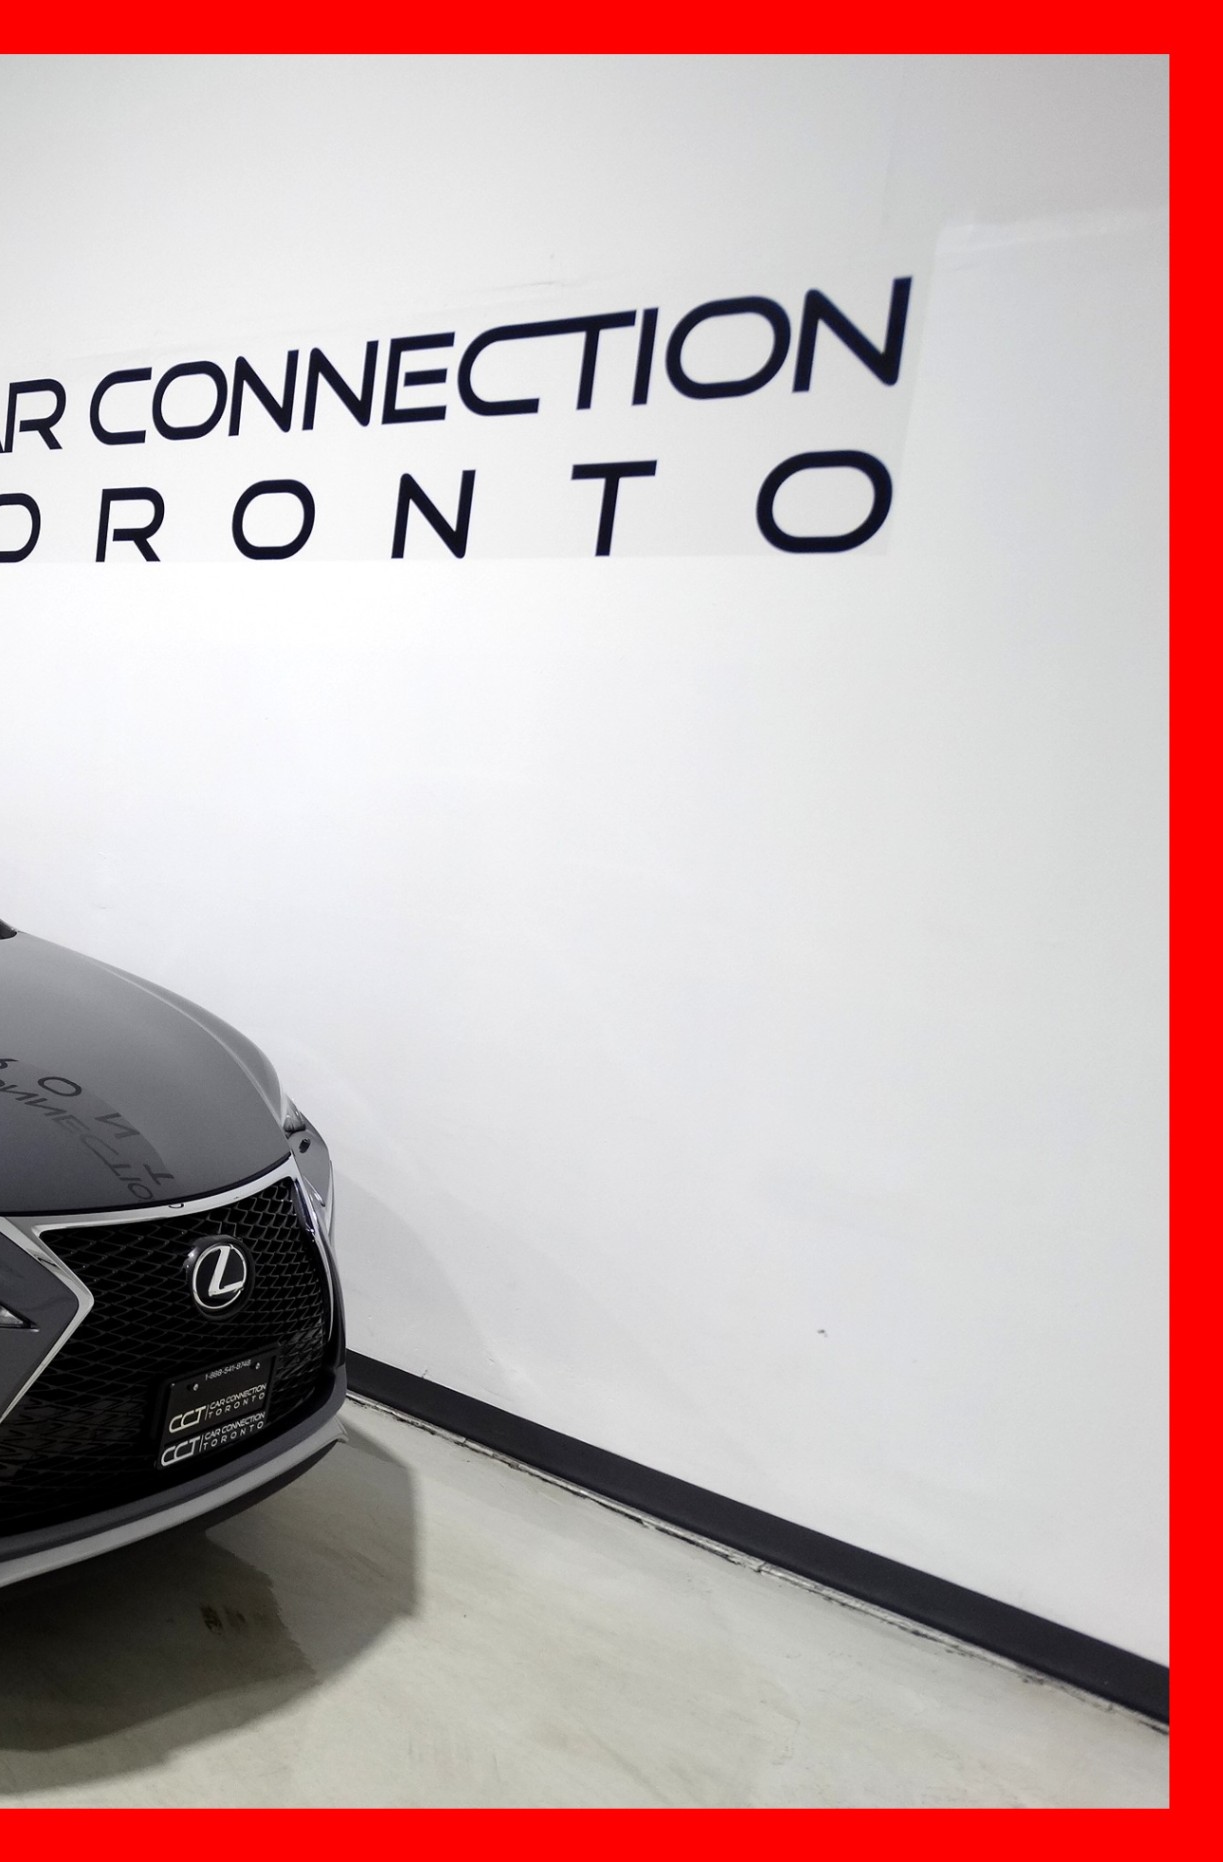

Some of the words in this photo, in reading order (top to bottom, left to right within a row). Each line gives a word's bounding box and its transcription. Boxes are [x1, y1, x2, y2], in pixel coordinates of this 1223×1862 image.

[89, 276, 912, 446] CONNECTION
[208, 1392, 265, 1419] TORONTO
[209, 1398, 225, 1410] CAR
[226, 1383, 267, 1404] CONNECTION
[169, 1406, 206, 1433] CCT
[204, 1428, 221, 1440] CAR
[221, 1411, 266, 1434] CONNECTION
[203, 1421, 264, 1450] TORONTO
[161, 1436, 200, 1466] CCT
